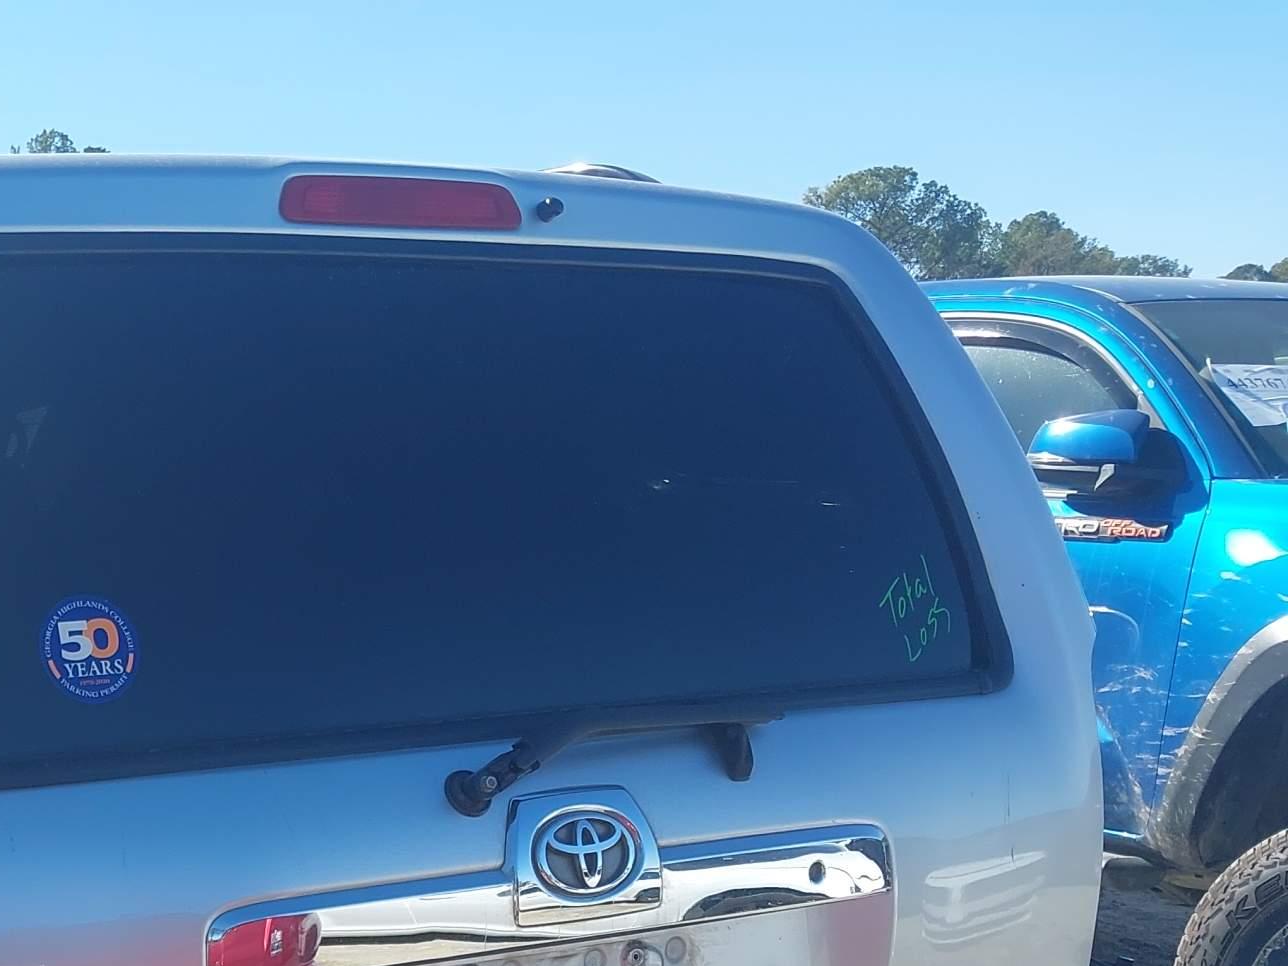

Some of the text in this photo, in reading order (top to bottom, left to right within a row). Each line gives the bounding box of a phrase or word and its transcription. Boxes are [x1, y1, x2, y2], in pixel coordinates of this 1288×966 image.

[1101, 518, 1132, 528] OFF
[1108, 527, 1161, 538] ROAD
[879, 554, 935, 627] Total
[57, 600, 109, 616] HIGHLANDS
[57, 617, 119, 661] 50
[63, 659, 124, 678] YEARS
[60, 673, 128, 698] PARKING PERMIT
